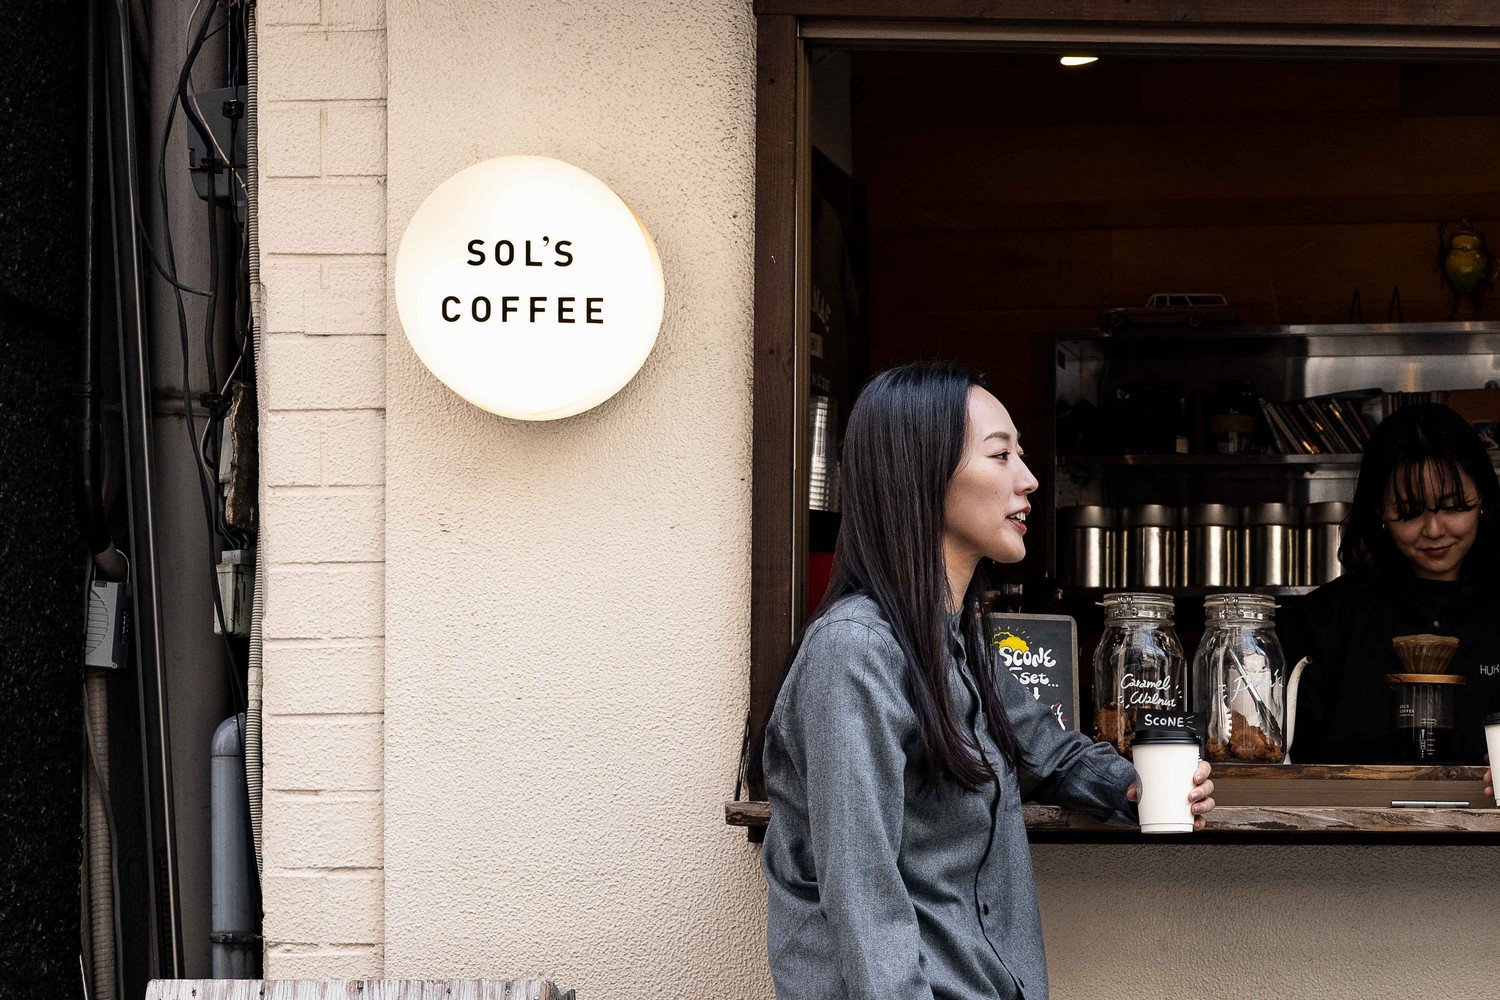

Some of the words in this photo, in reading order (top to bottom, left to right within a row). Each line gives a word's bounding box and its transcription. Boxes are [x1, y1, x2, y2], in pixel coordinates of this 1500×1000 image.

[466, 235, 574, 267] SOL'S
[441, 295, 604, 324] COFFEE
[998, 646, 1057, 668] SCONE
[1120, 673, 1171, 691] Caramel
[1130, 690, 1177, 707] Walnut
[1144, 713, 1185, 728] SCONE
